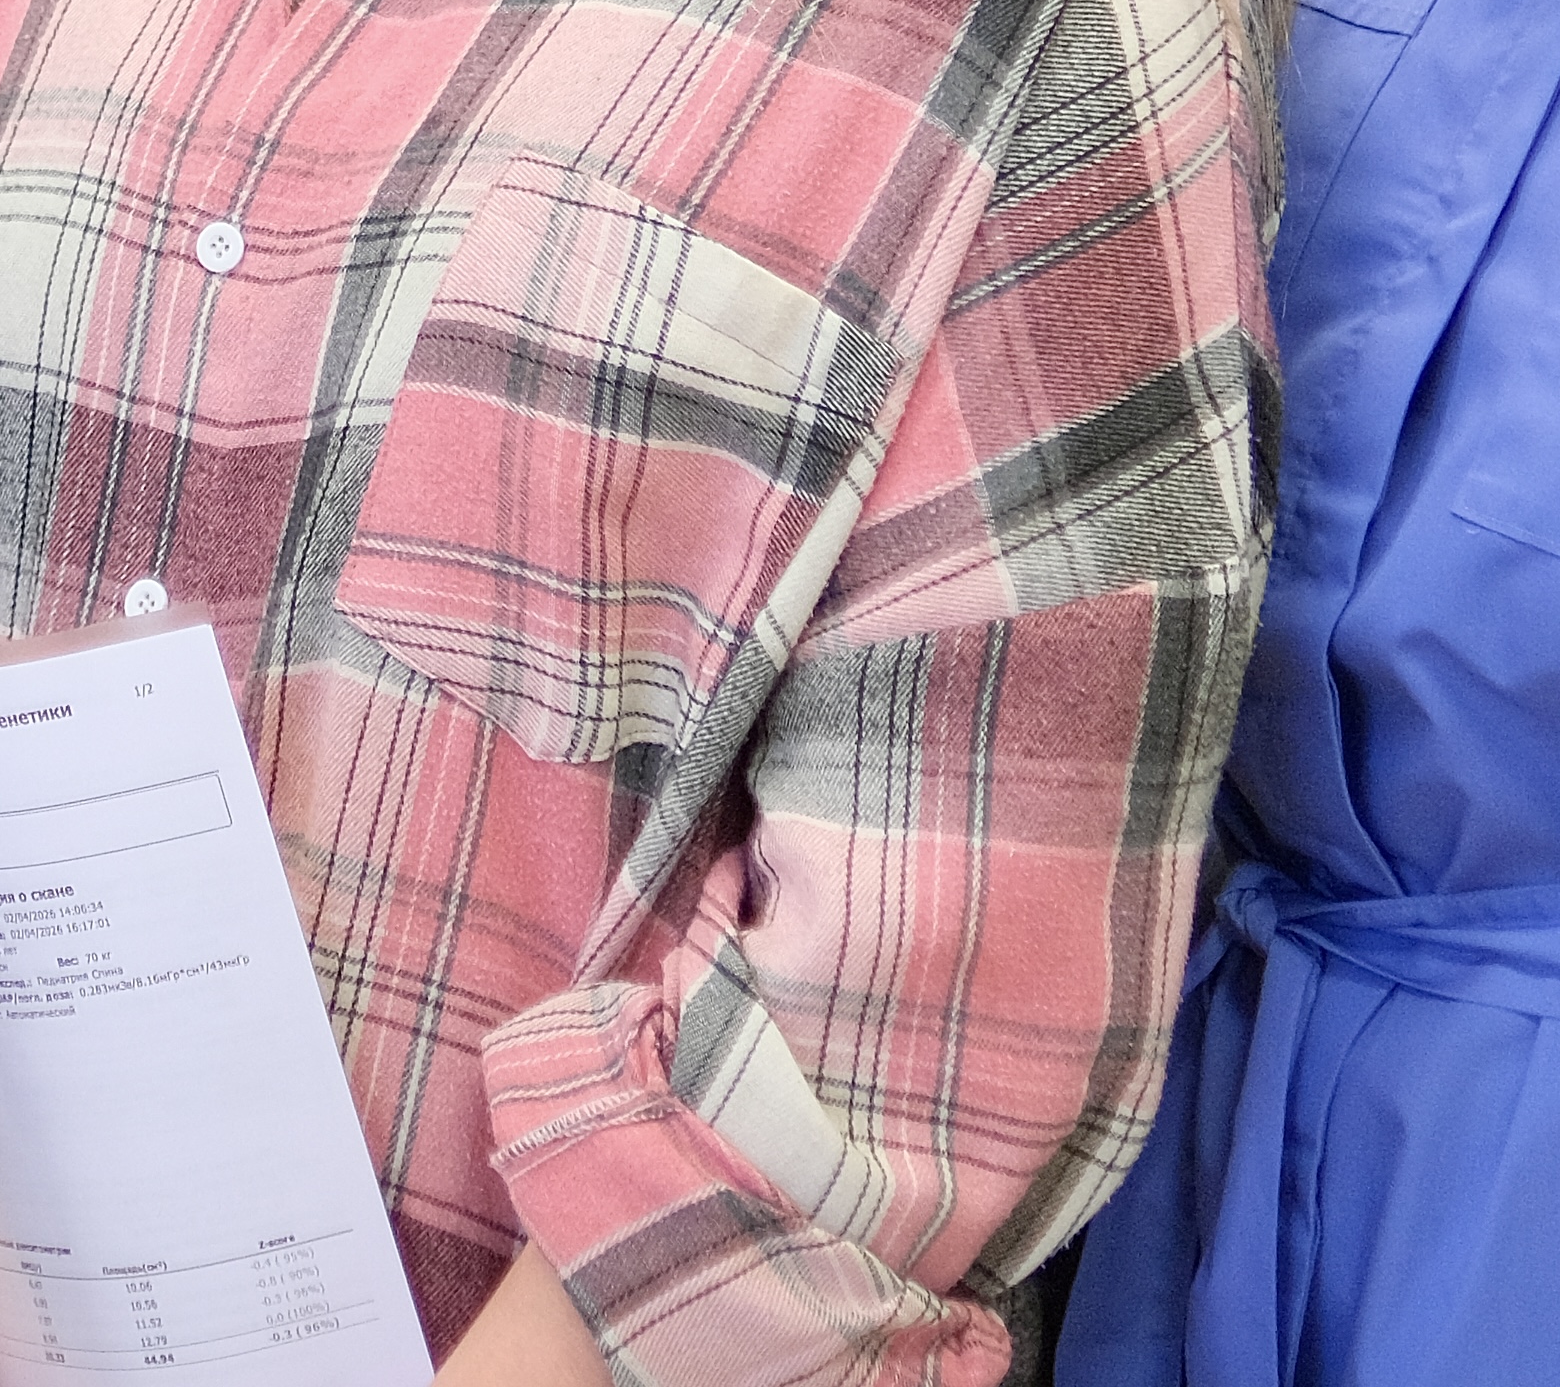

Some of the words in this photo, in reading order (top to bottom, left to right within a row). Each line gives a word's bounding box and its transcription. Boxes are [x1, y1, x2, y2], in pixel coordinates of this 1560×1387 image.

[134, 683, 155, 698] 1/2
[19, 893, 27, 903] о
[31, 886, 74, 901] скане
[86, 952, 98, 964] 70
